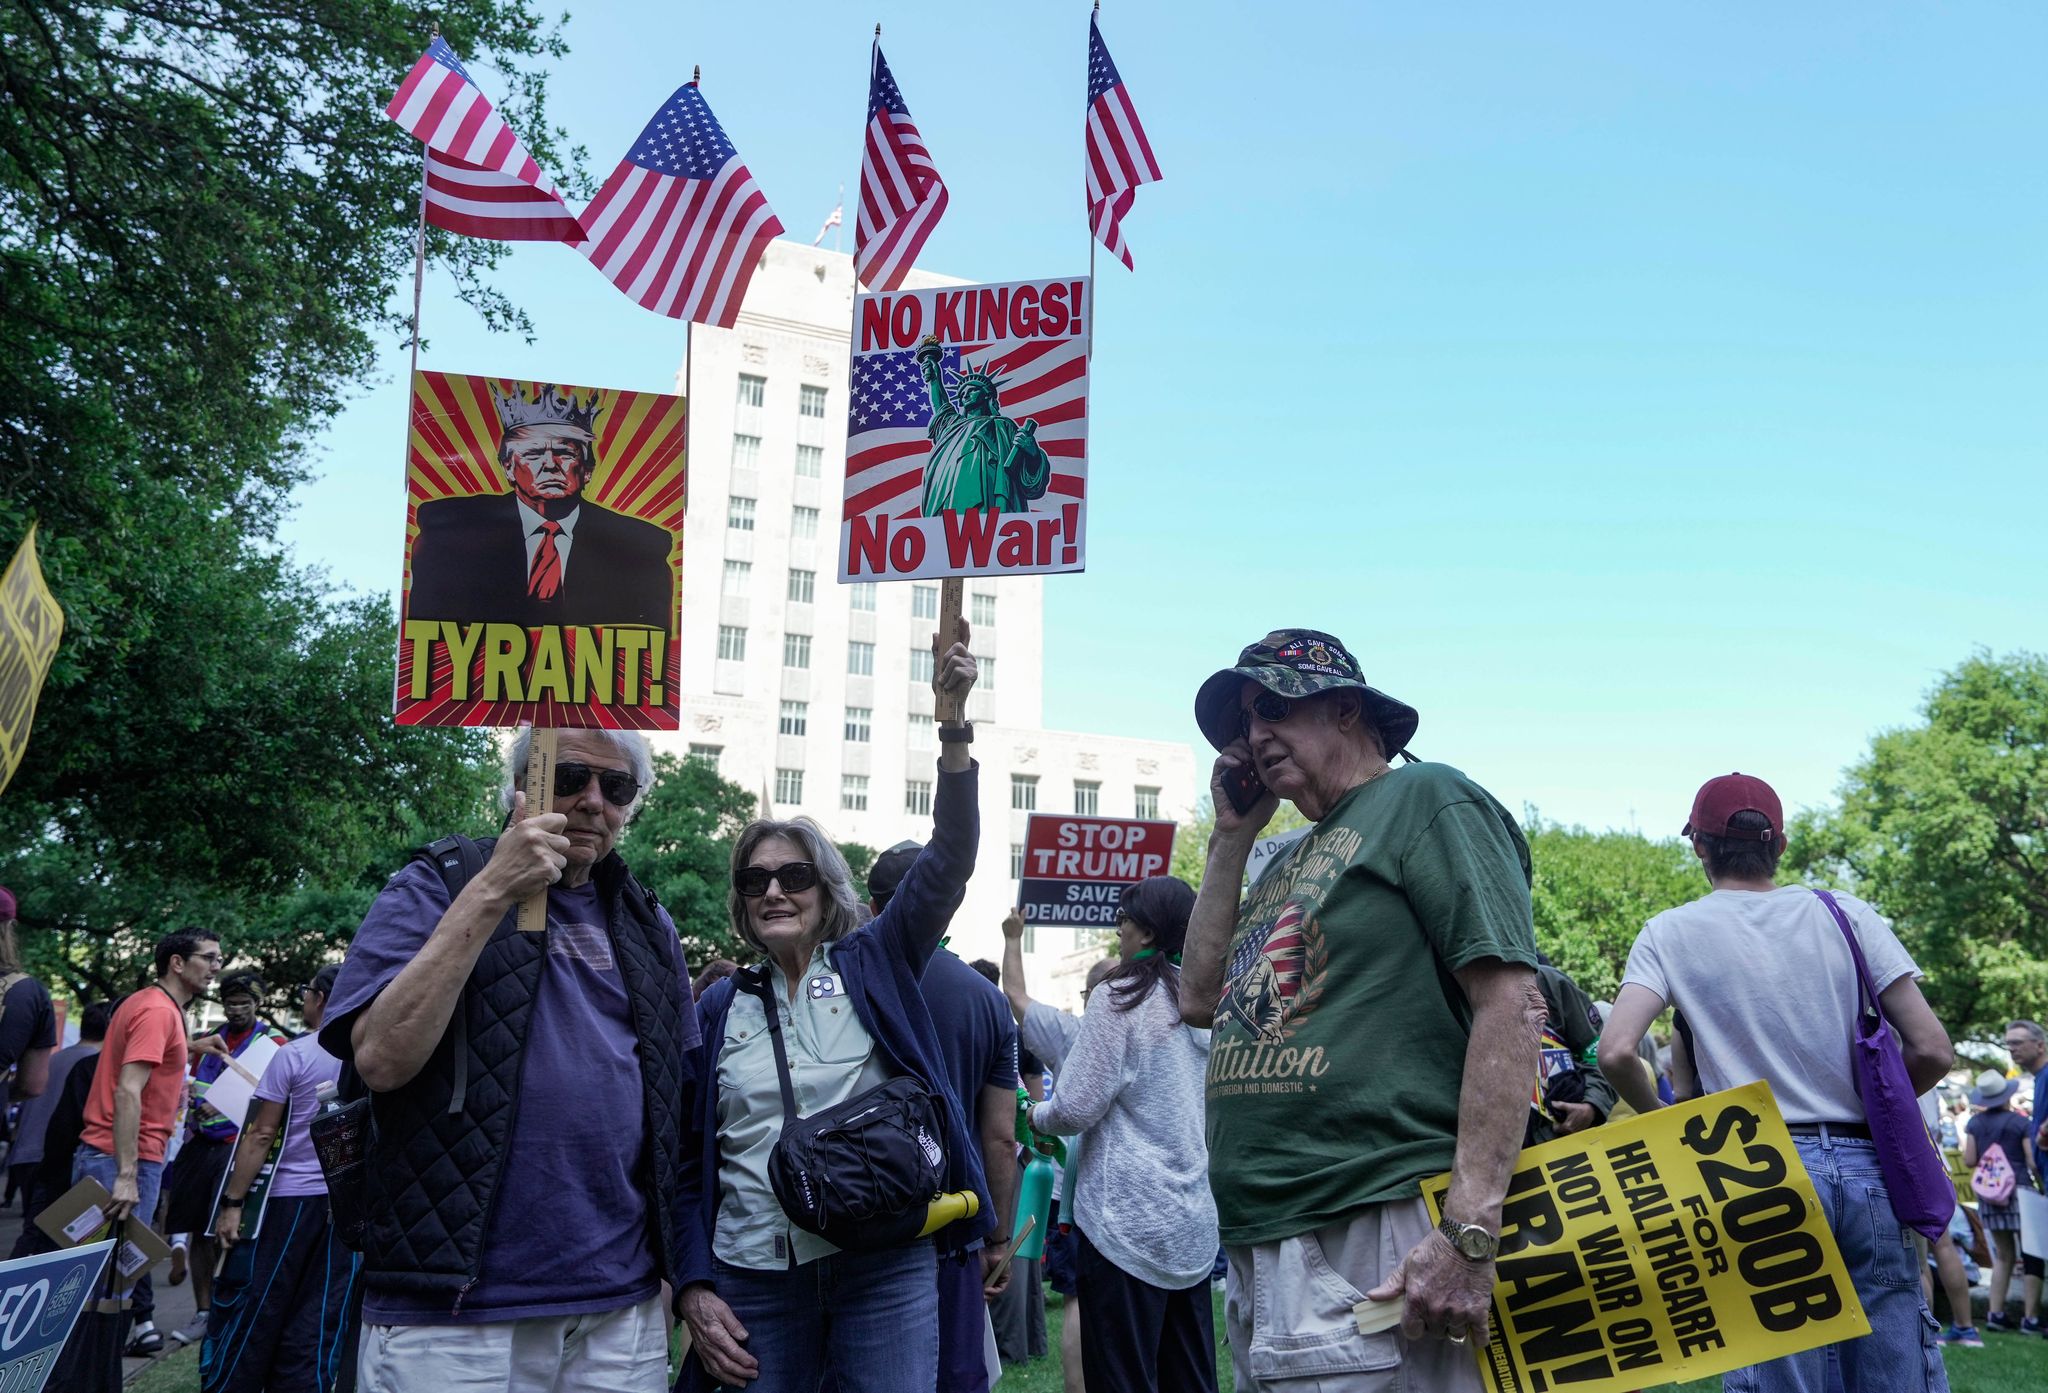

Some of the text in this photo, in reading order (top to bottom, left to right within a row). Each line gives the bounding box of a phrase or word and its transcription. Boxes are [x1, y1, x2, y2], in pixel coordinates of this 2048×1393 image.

[861, 281, 1084, 351] NO KINGS!
[848, 502, 1080, 576] No War!
[404, 619, 666, 706] TYRANT!
[1289, 639, 1347, 660] ALL GAVE SOME
[1297, 663, 1344, 676] SOME GAVE ALL
[1057, 822, 1146, 850] STOP
[1254, 846, 1264, 860] A
[1033, 849, 1163, 878] TRUMP
[1025, 903, 1117, 922] DEMOCR
[1066, 885, 1122, 903] SAVE
[1219, 1083, 1243, 1097] FOREIGN
[1245, 1083, 1260, 1094] AND
[1261, 1081, 1304, 1094] DOMESTIC
[800, 1170, 814, 1209] BOREALIS
[1680, 1105, 1843, 1333] $200B
[1680, 1194, 1729, 1278] FOR
[1545, 1152, 1664, 1372] NOT WAR ON
[1606, 1139, 1726, 1359] HEALTHCARE
[1496, 1166, 1615, 1393] IRAN!
[0, 1278, 49, 1351] FO
